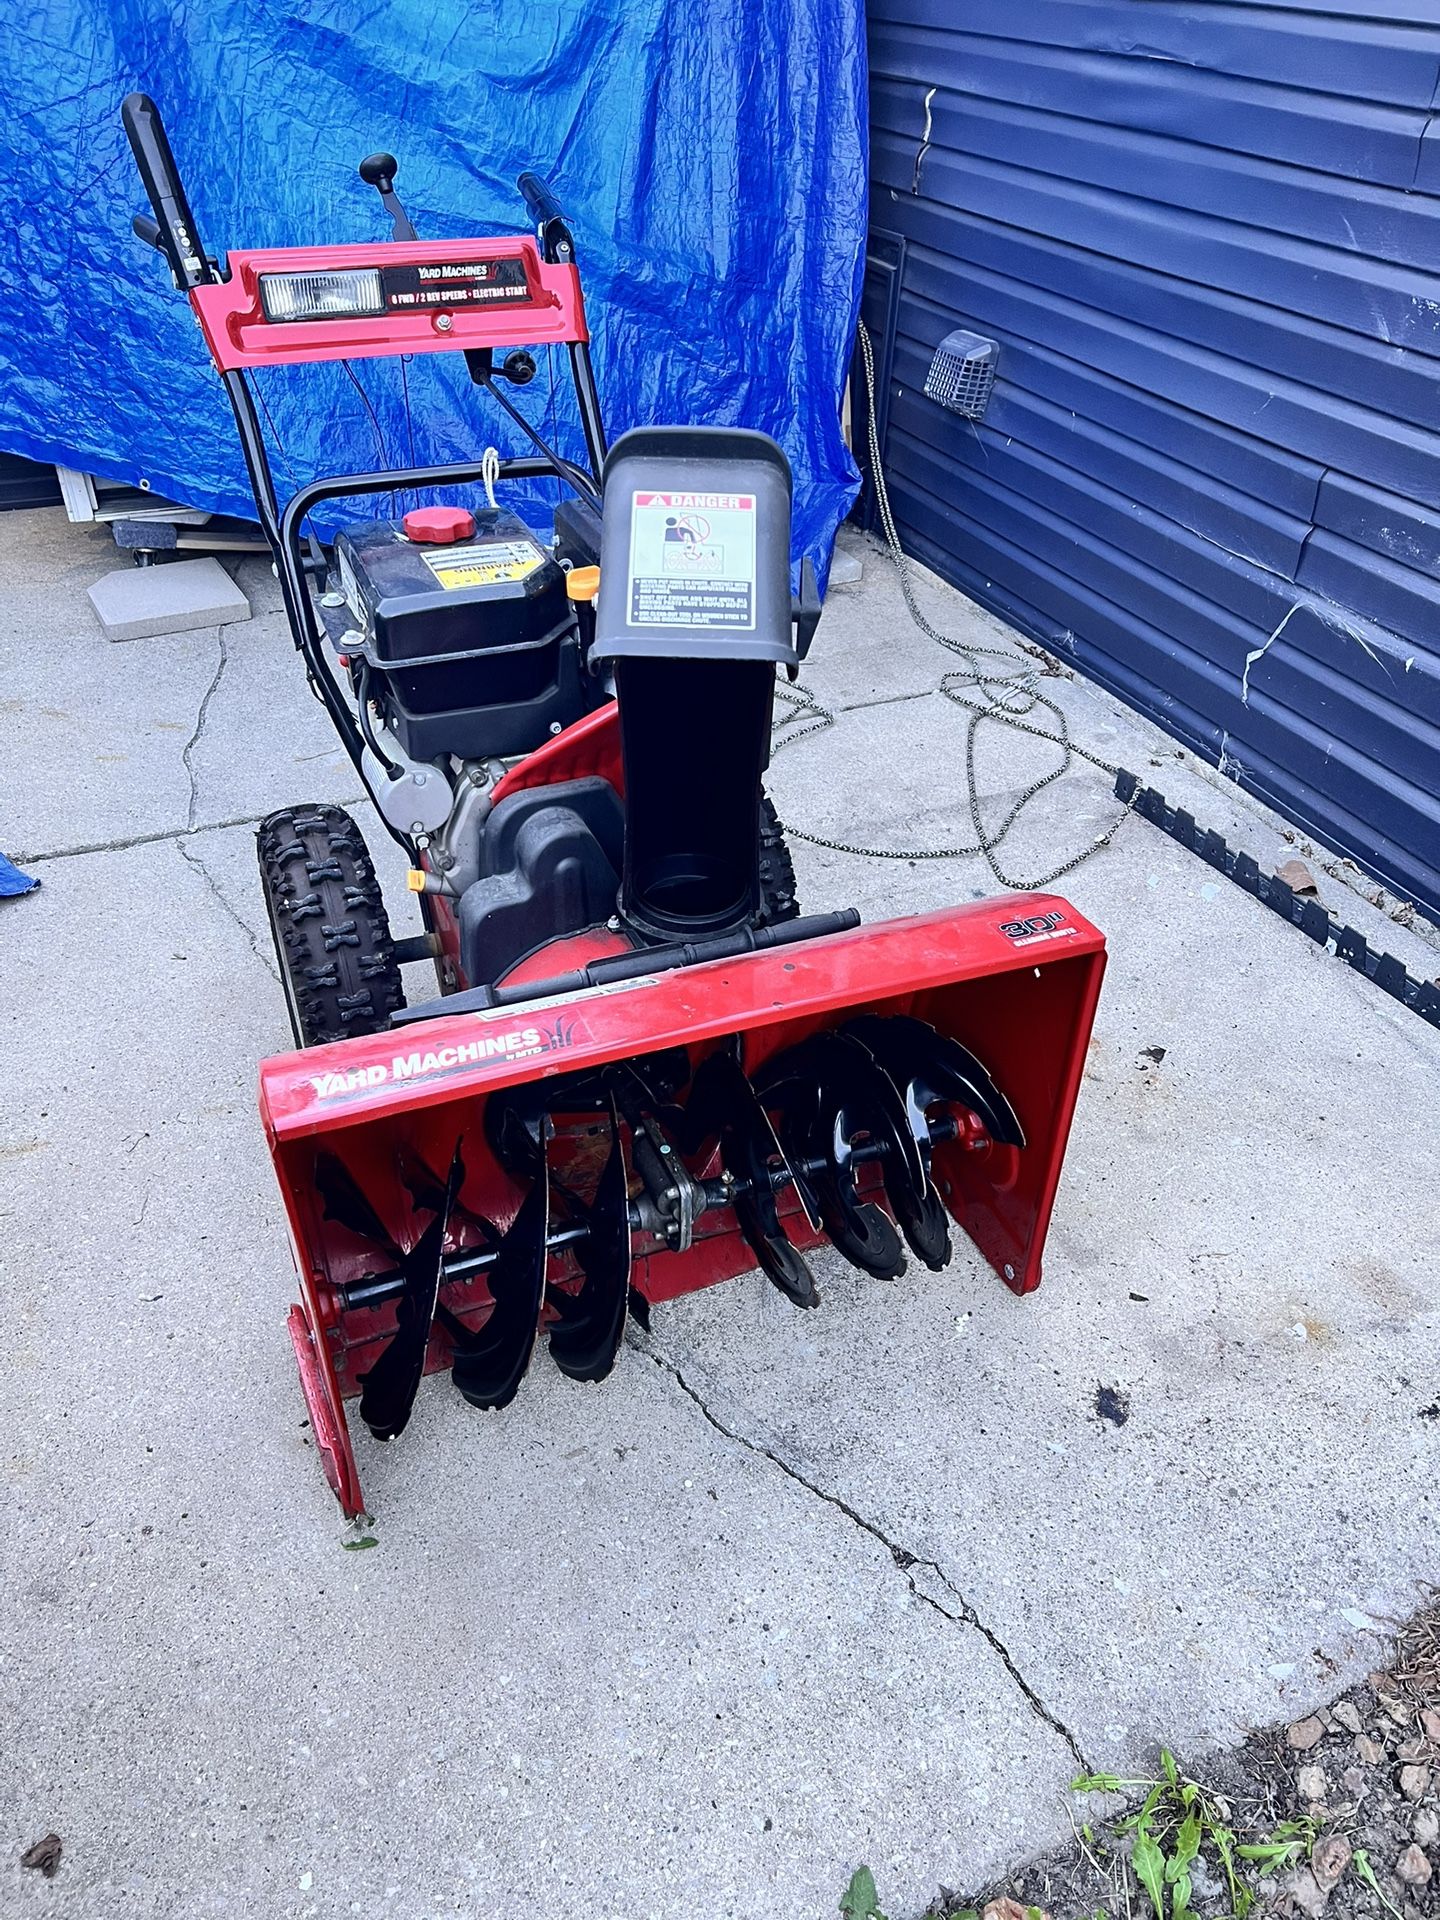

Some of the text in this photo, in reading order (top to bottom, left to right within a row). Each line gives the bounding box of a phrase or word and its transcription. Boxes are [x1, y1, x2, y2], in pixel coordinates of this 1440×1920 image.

[418, 265, 487, 279] YARD MACHINES
[398, 293, 415, 304] FWD
[420, 292, 426, 303] 2
[426, 291, 440, 302] REV
[441, 290, 468, 301] SPEEDS
[472, 287, 505, 299] ELECTRIC
[505, 286, 527, 296] START
[671, 495, 741, 510] DANGER
[999, 912, 1066, 939] 30"
[515, 1046, 543, 1059] MTD
[310, 1028, 541, 1098] YARD MACHINES
